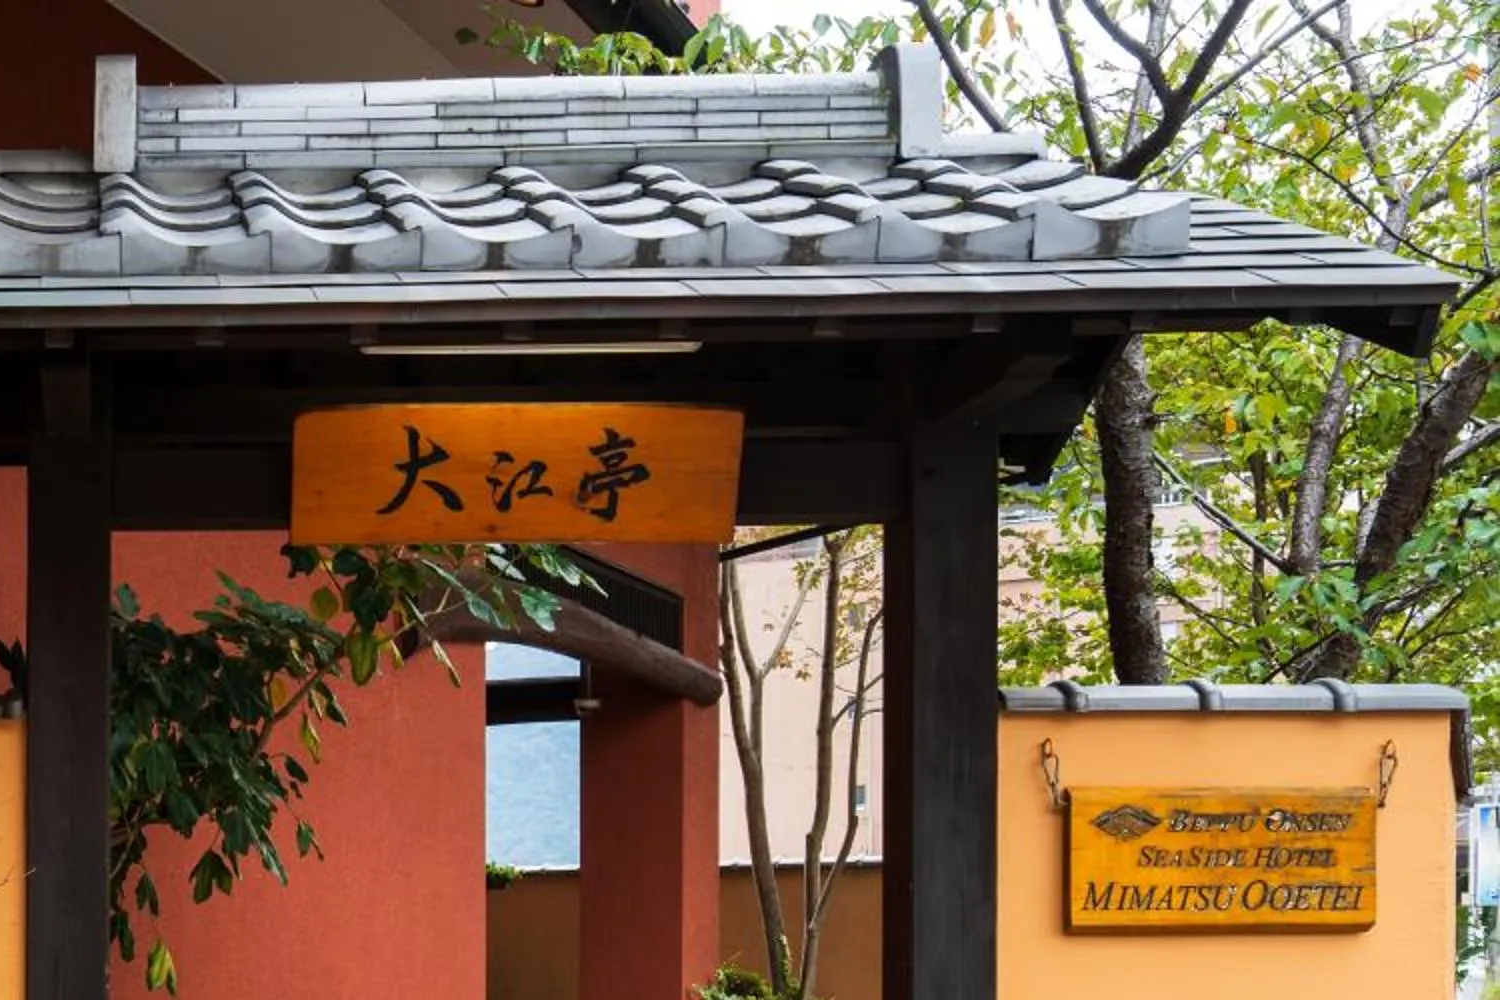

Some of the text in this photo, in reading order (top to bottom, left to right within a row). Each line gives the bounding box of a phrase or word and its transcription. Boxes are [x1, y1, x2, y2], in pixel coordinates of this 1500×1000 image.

[376, 426, 650, 522] 大江亭
[1252, 847, 1338, 869] HOTEL
[1081, 879, 1364, 911] MIMATSU OOETEI
